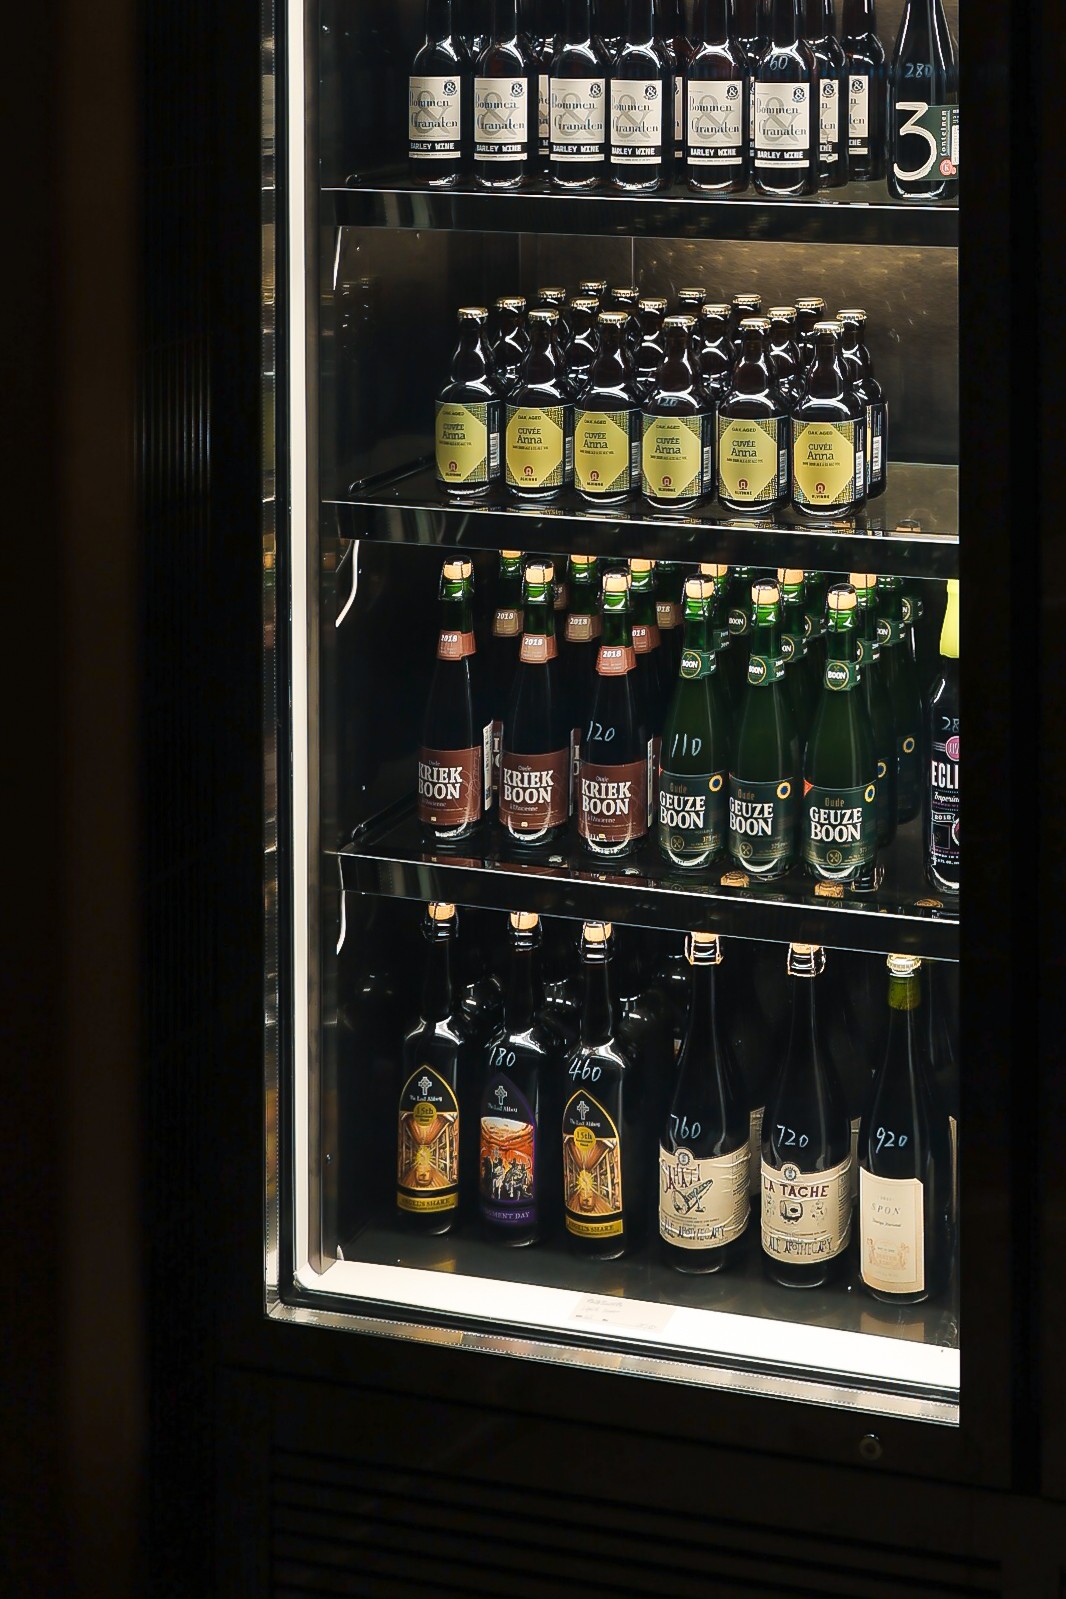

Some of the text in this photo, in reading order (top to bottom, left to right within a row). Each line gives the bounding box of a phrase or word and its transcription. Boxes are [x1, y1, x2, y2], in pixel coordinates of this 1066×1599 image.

[905, 63, 934, 78] 280
[692, 116, 739, 134] Granaten
[894, 102, 937, 181] 3
[517, 435, 542, 444] Anna
[655, 445, 681, 454] Anna
[807, 451, 834, 460] Anna
[525, 638, 542, 646] 2018
[603, 650, 621, 658] 2018
[827, 670, 846, 680] BOON
[587, 721, 615, 741] 120
[671, 734, 701, 757] 110
[504, 768, 554, 787] KRIEK
[504, 785, 552, 803] BOON
[582, 778, 631, 798] KRIEK
[582, 797, 629, 815] BOON
[660, 792, 706, 812] GEUZE
[729, 798, 774, 819] GEUZE
[660, 811, 704, 829] BOON
[729, 815, 773, 836] BOON
[810, 807, 862, 825] GEUZE
[811, 822, 862, 842] BOON
[489, 1048, 516, 1067] 180
[569, 1059, 601, 1081] 460
[670, 1114, 700, 1139] 760
[777, 1125, 809, 1148] 720
[876, 1128, 908, 1153] 920
[764, 1180, 829, 1197] LA TACHE
